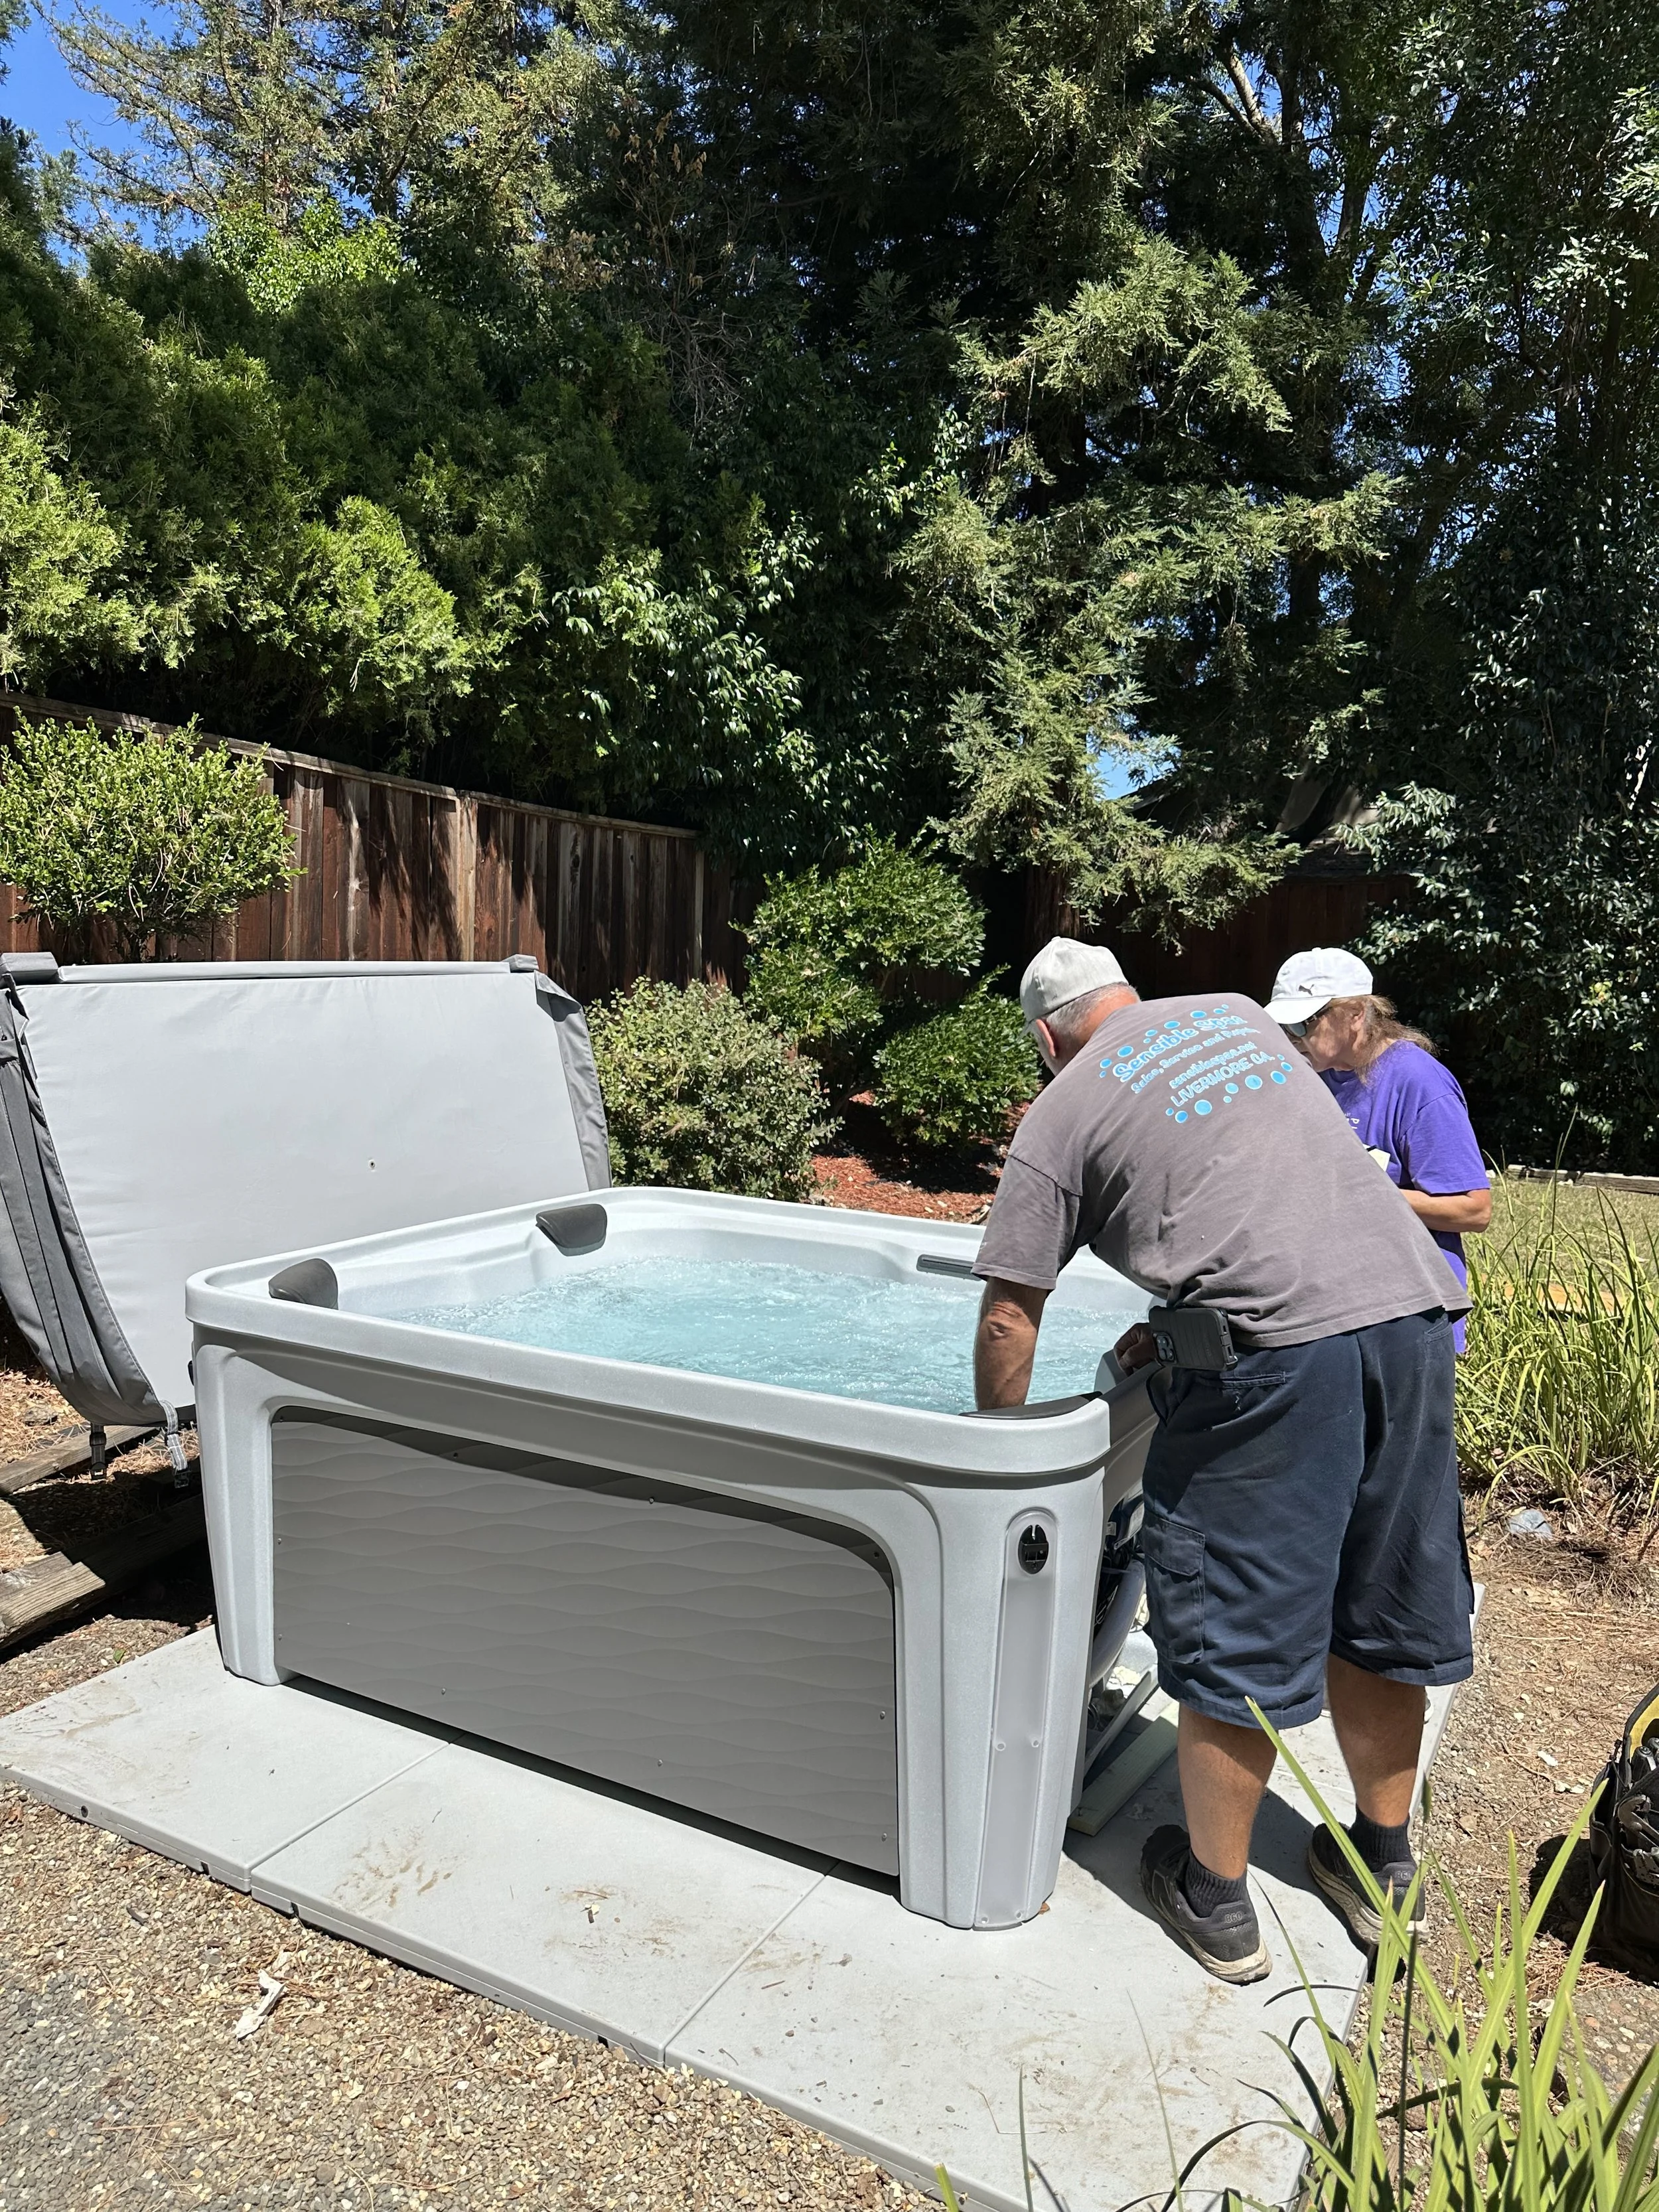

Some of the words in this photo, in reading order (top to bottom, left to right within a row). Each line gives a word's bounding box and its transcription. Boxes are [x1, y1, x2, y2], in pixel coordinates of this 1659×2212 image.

[1113, 1029, 1199, 1082] Sensible
[1159, 1045, 1203, 1068] Service
[1202, 1033, 1225, 1047] and
[1171, 1057, 1254, 1106] LIVERMORE
[1225, 1911, 1242, 1923] 860
